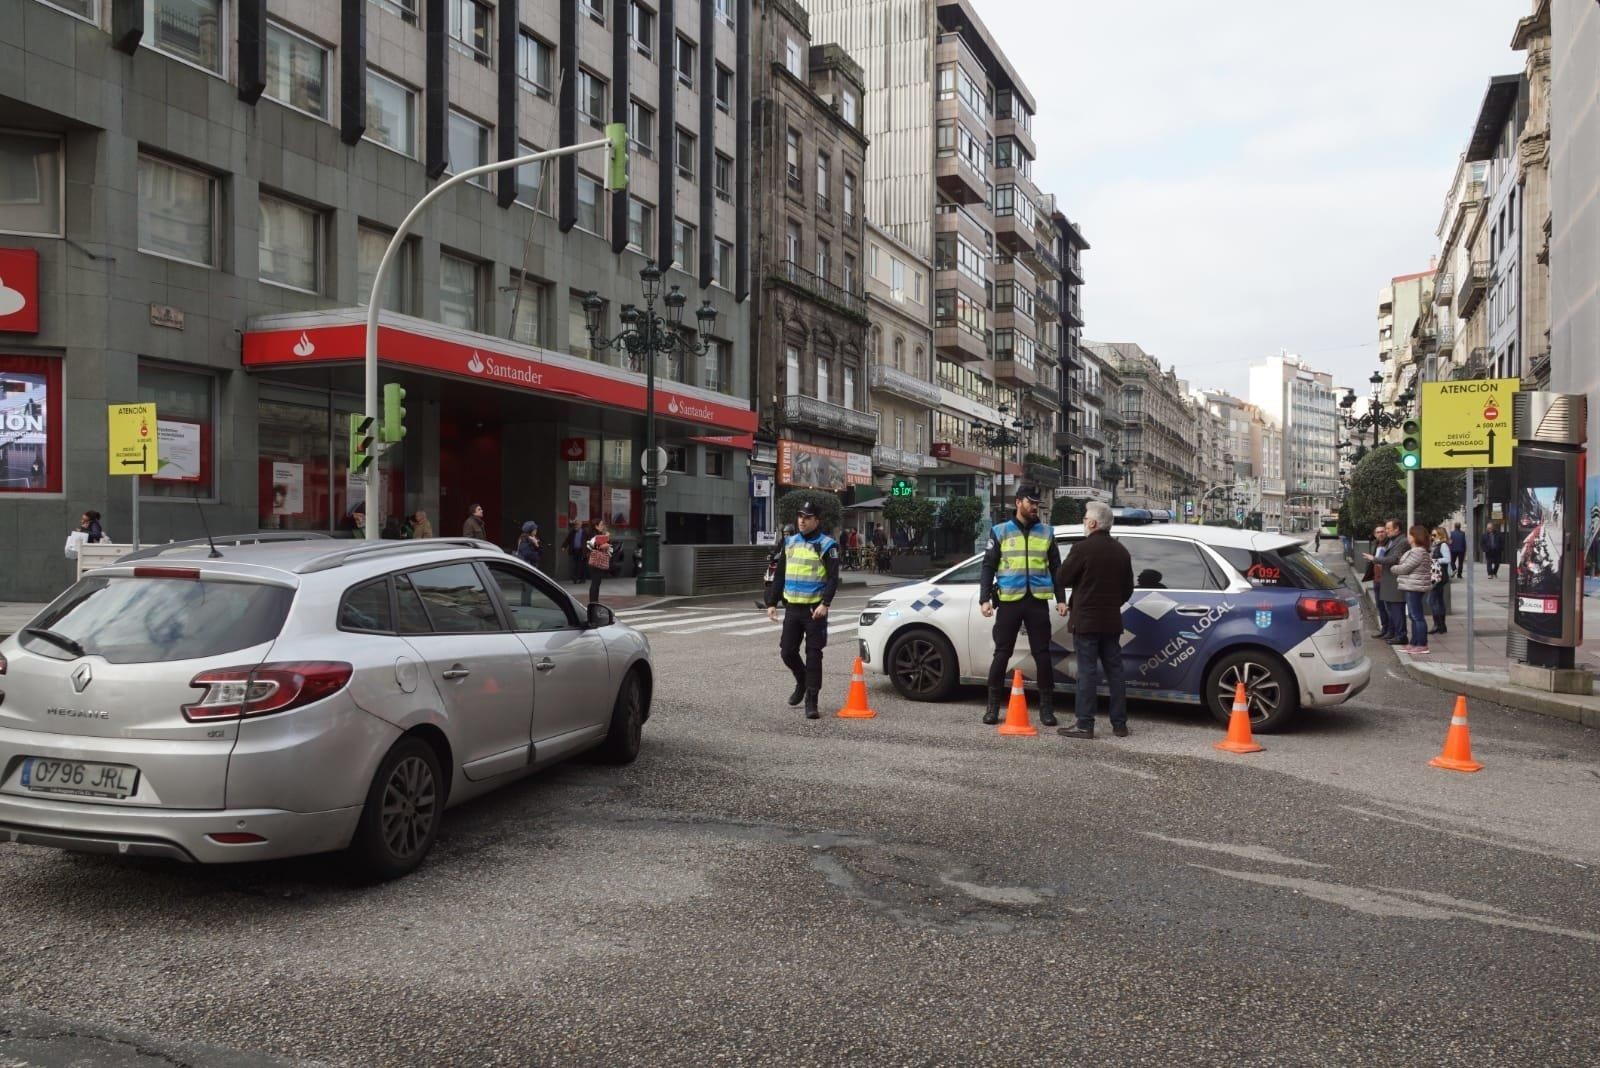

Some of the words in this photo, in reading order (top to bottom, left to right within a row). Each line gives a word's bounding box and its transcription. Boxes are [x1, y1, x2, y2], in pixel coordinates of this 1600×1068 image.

[486, 357, 543, 385] Santander
[1440, 382, 1498, 394] ATENCIÓN
[679, 400, 714, 420] Santander
[1259, 567, 1280, 578] 092
[1139, 636, 1188, 676] POLICÍA
[1192, 602, 1235, 633] LOCAL
[1168, 646, 1196, 667] VIGO
[35, 761, 85, 784] 0796
[91, 767, 128, 791] JRL
